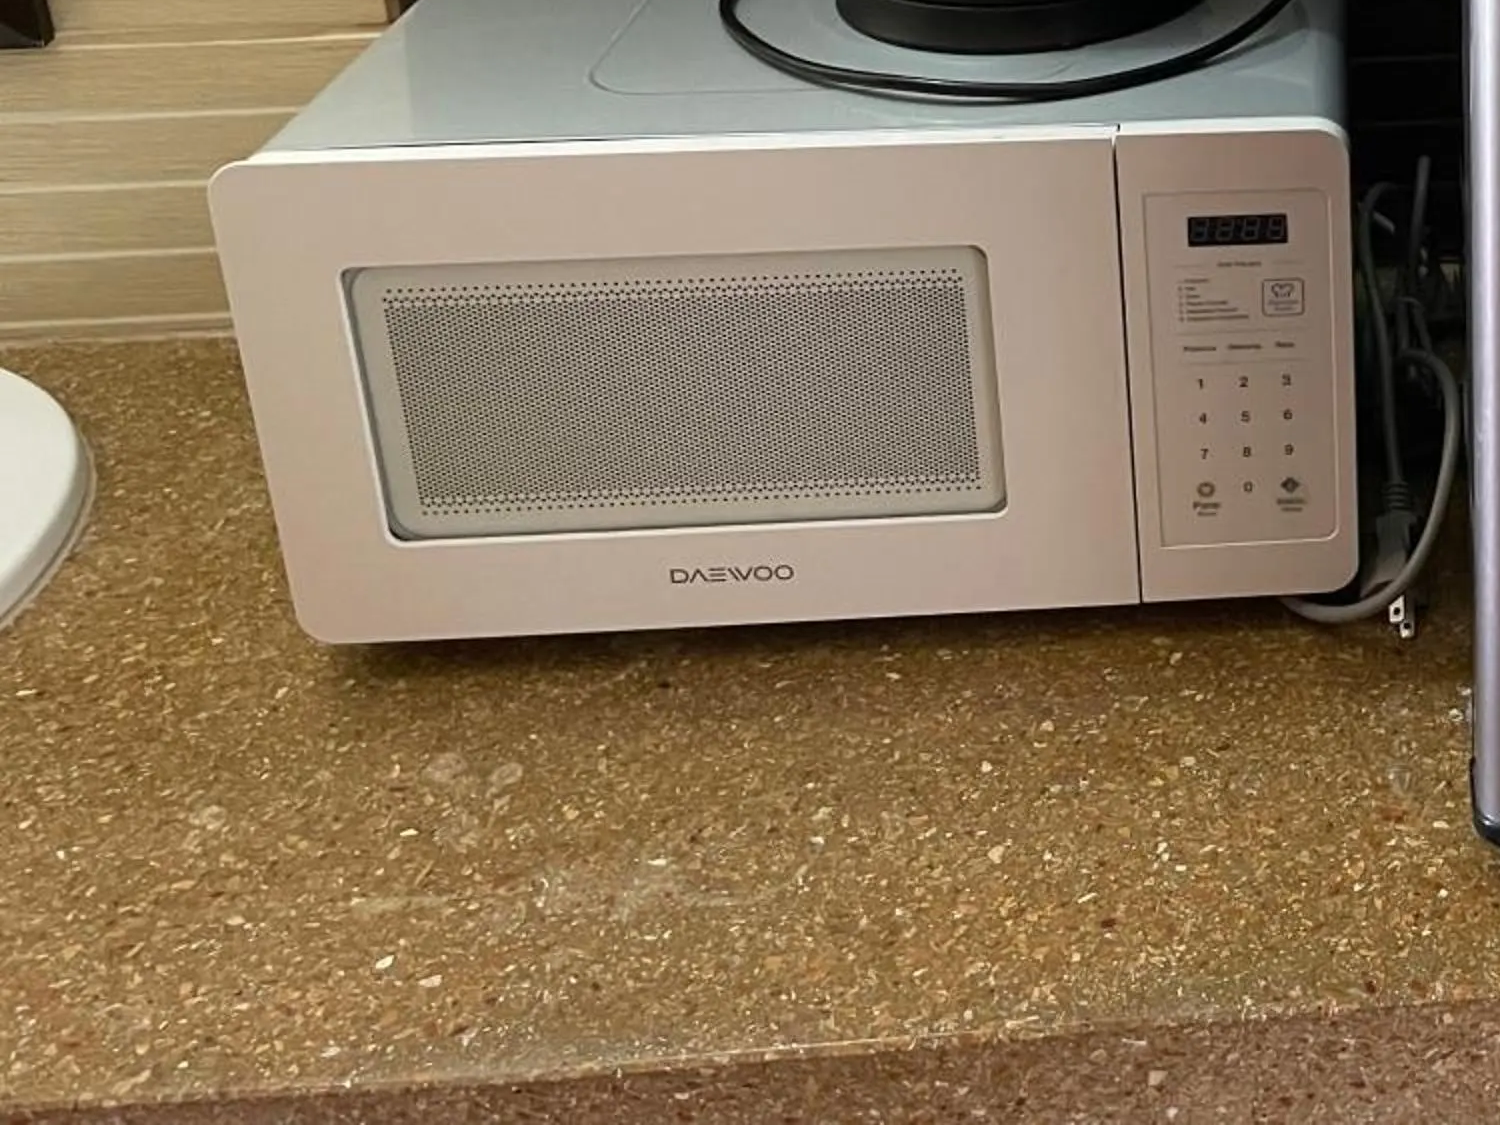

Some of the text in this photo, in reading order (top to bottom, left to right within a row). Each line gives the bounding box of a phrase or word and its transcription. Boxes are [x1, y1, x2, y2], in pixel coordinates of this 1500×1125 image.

[1198, 374, 1292, 390] 1 2 3
[1199, 409, 1293, 424] 4 5 6
[1200, 443, 1295, 460] 7 8 9
[1243, 481, 1253, 493] 0
[670, 565, 795, 584] DAEWOO
